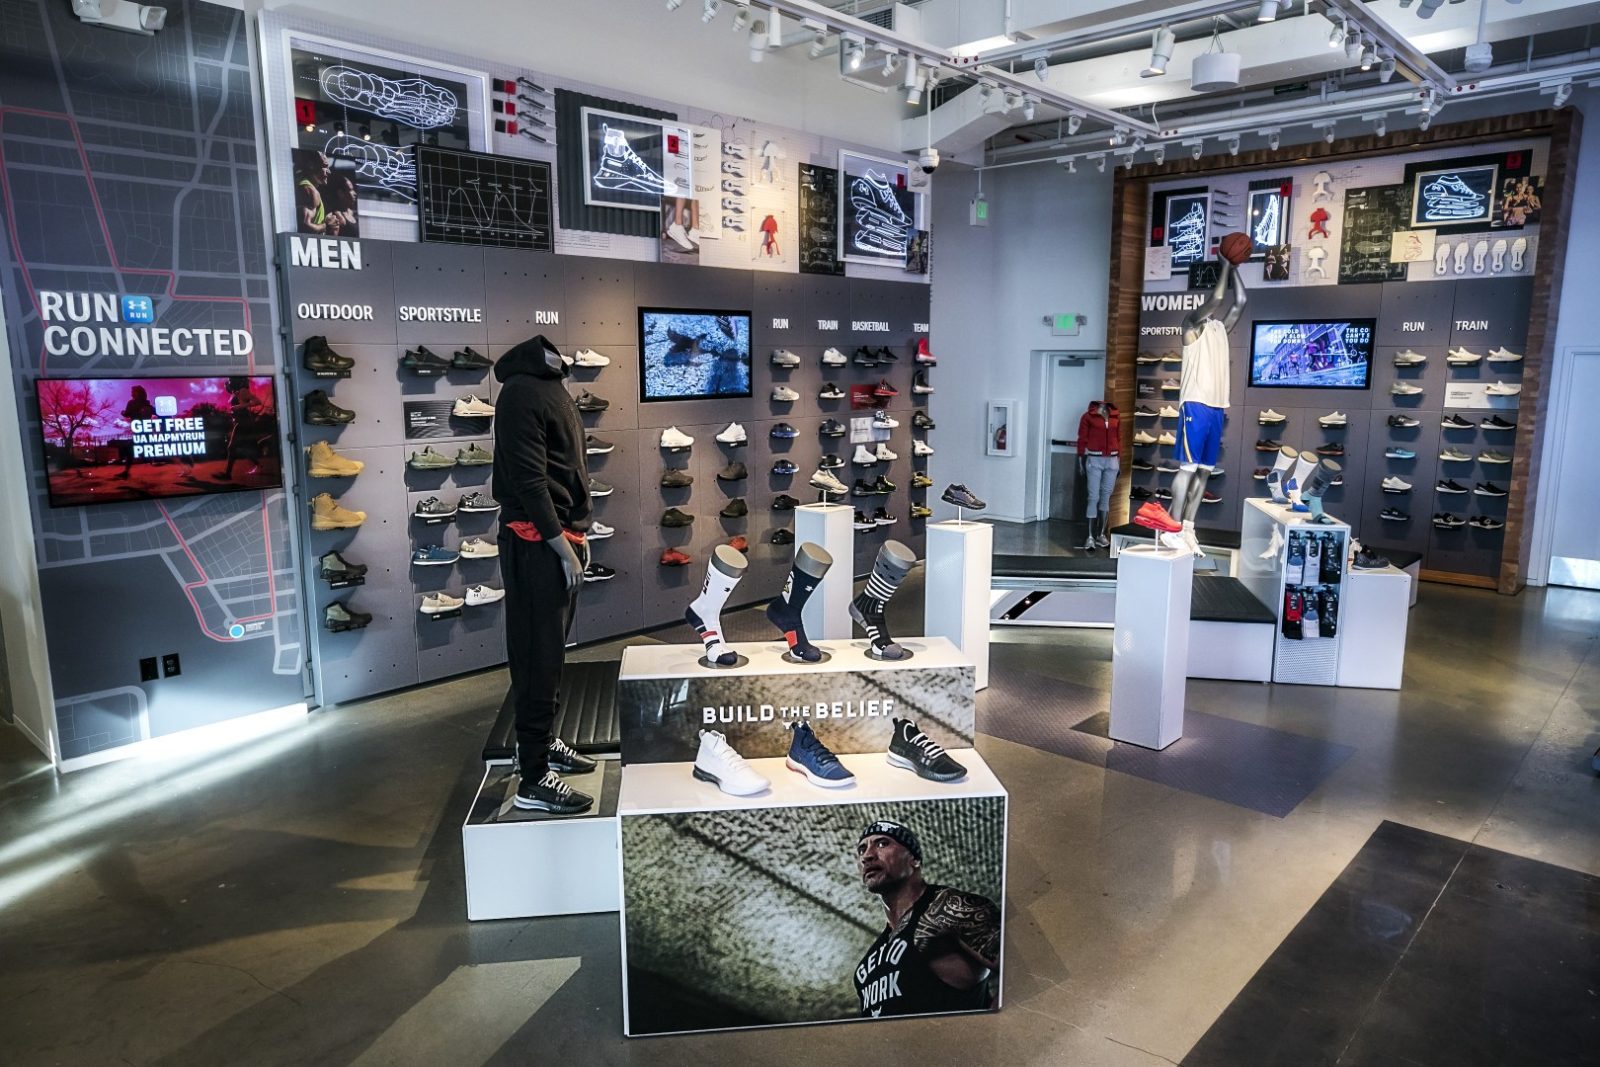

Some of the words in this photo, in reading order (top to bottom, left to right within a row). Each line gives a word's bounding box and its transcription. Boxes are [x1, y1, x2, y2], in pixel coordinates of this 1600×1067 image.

[290, 236, 362, 270] MEN
[40, 290, 119, 322] RUN
[1141, 294, 1205, 311] WOMEN
[297, 302, 374, 321] OUTDOOR
[399, 305, 482, 323] SPORTSTYLE
[535, 310, 559, 325] RUN
[772, 318, 789, 330] RUN
[817, 319, 839, 331] TRAIN
[851, 321, 890, 332] BASKETBALL
[913, 323, 929, 333] TEAM
[1140, 326, 1183, 336] SPORTSTYL
[1402, 321, 1426, 332] RUN
[1455, 320, 1489, 331] TRAIN
[43, 325, 254, 357] CONNECTED
[130, 418, 163, 433] GET
[165, 417, 204, 432] FREE
[132, 434, 148, 444] UA
[148, 431, 206, 443] MAPMYRUN
[133, 441, 207, 458] PREMIUM
[702, 703, 774, 725] BUILD
[780, 705, 811, 718] THE
[815, 699, 894, 720] BELIEF
[856, 943, 887, 984] GET
[886, 938, 908, 965] TO
[861, 970, 902, 1012] WORK
